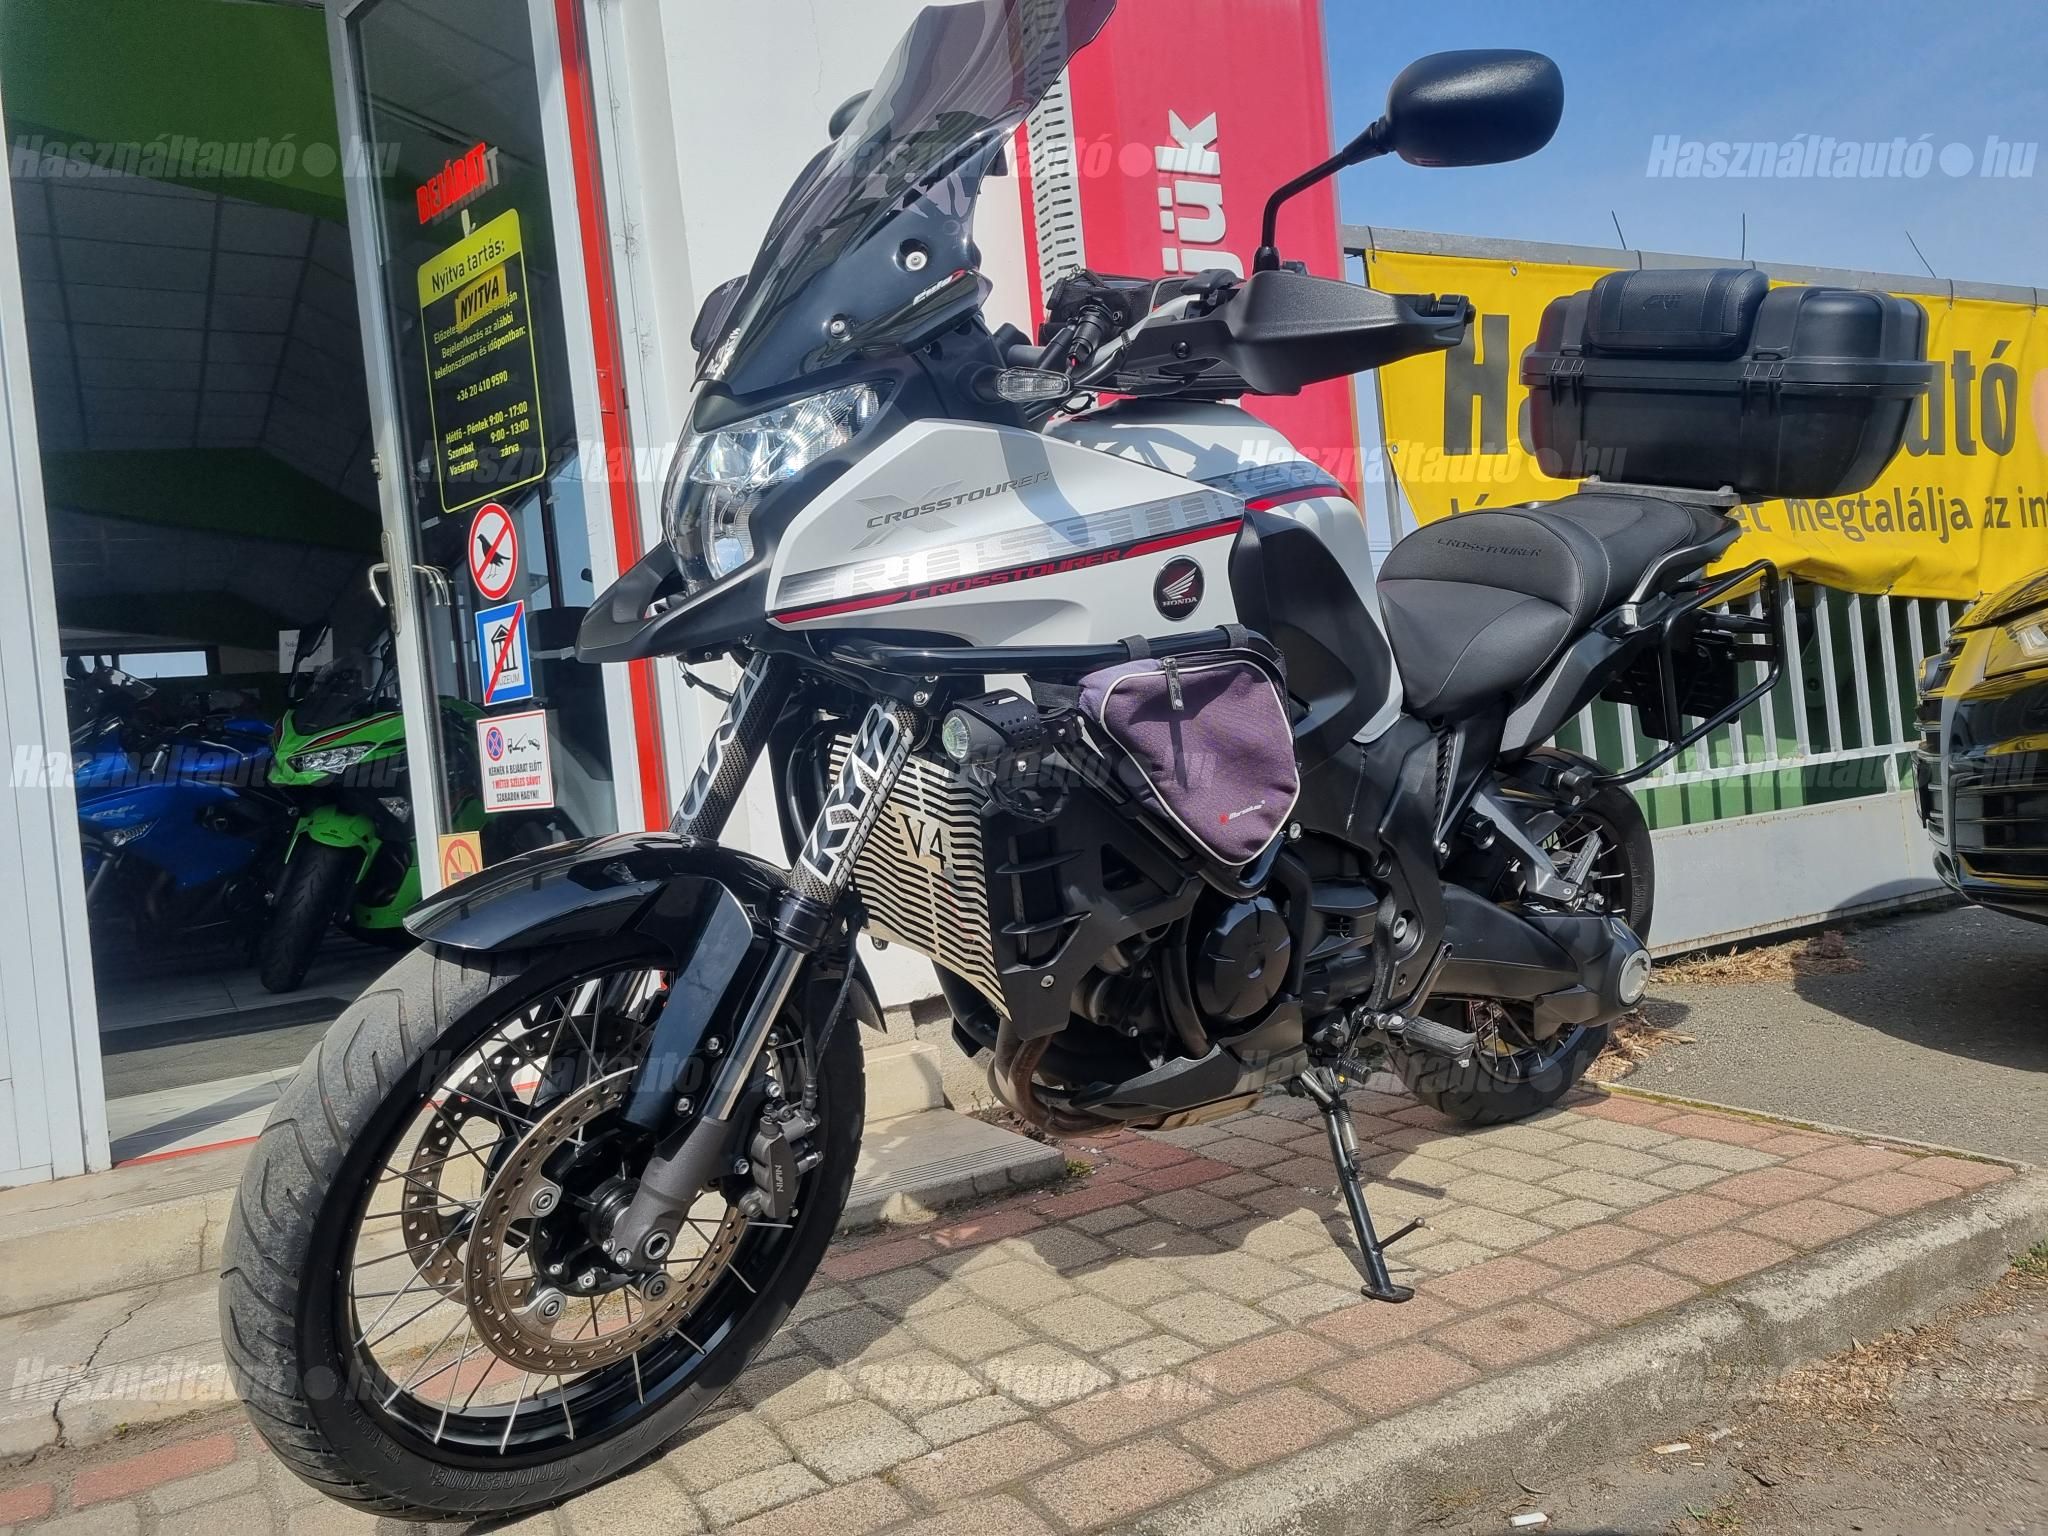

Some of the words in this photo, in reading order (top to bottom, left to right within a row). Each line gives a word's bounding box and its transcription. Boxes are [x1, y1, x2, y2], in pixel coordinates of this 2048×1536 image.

[431, 262, 465, 293] Nyitva
[466, 238, 505, 271] tartás:
[460, 276, 499, 322] NYITVA
[441, 328, 484, 359] Bejelentkezés
[484, 324, 494, 337] az
[493, 311, 514, 333] alábbi
[435, 351, 479, 380] telefonszámon
[479, 344, 487, 358] és
[456, 388, 469, 402] +36
[469, 384, 478, 397] 20
[478, 378, 491, 394] 410
[490, 370, 508, 390] 9590
[447, 442, 474, 460] Szombat
[490, 428, 505, 444] 9:00
[511, 419, 529, 436] 13:00
[467, 418, 488, 437] Péntek
[489, 410, 504, 426] 9:00
[509, 401, 528, 418] 17:00
[449, 459, 479, 477] Vasárnap
[500, 442, 519, 458] zárva
[866, 471, 1049, 529] CROSSTOURER
[1783, 486, 1974, 544] megtalálja
[1984, 496, 2011, 529] az
[2017, 486, 2048, 529] in
[909, 550, 1121, 600] CROSSTOURER
[1162, 596, 1198, 606] HONDA
[835, 727, 914, 888] SUSPENSION
[899, 812, 947, 875] V4
